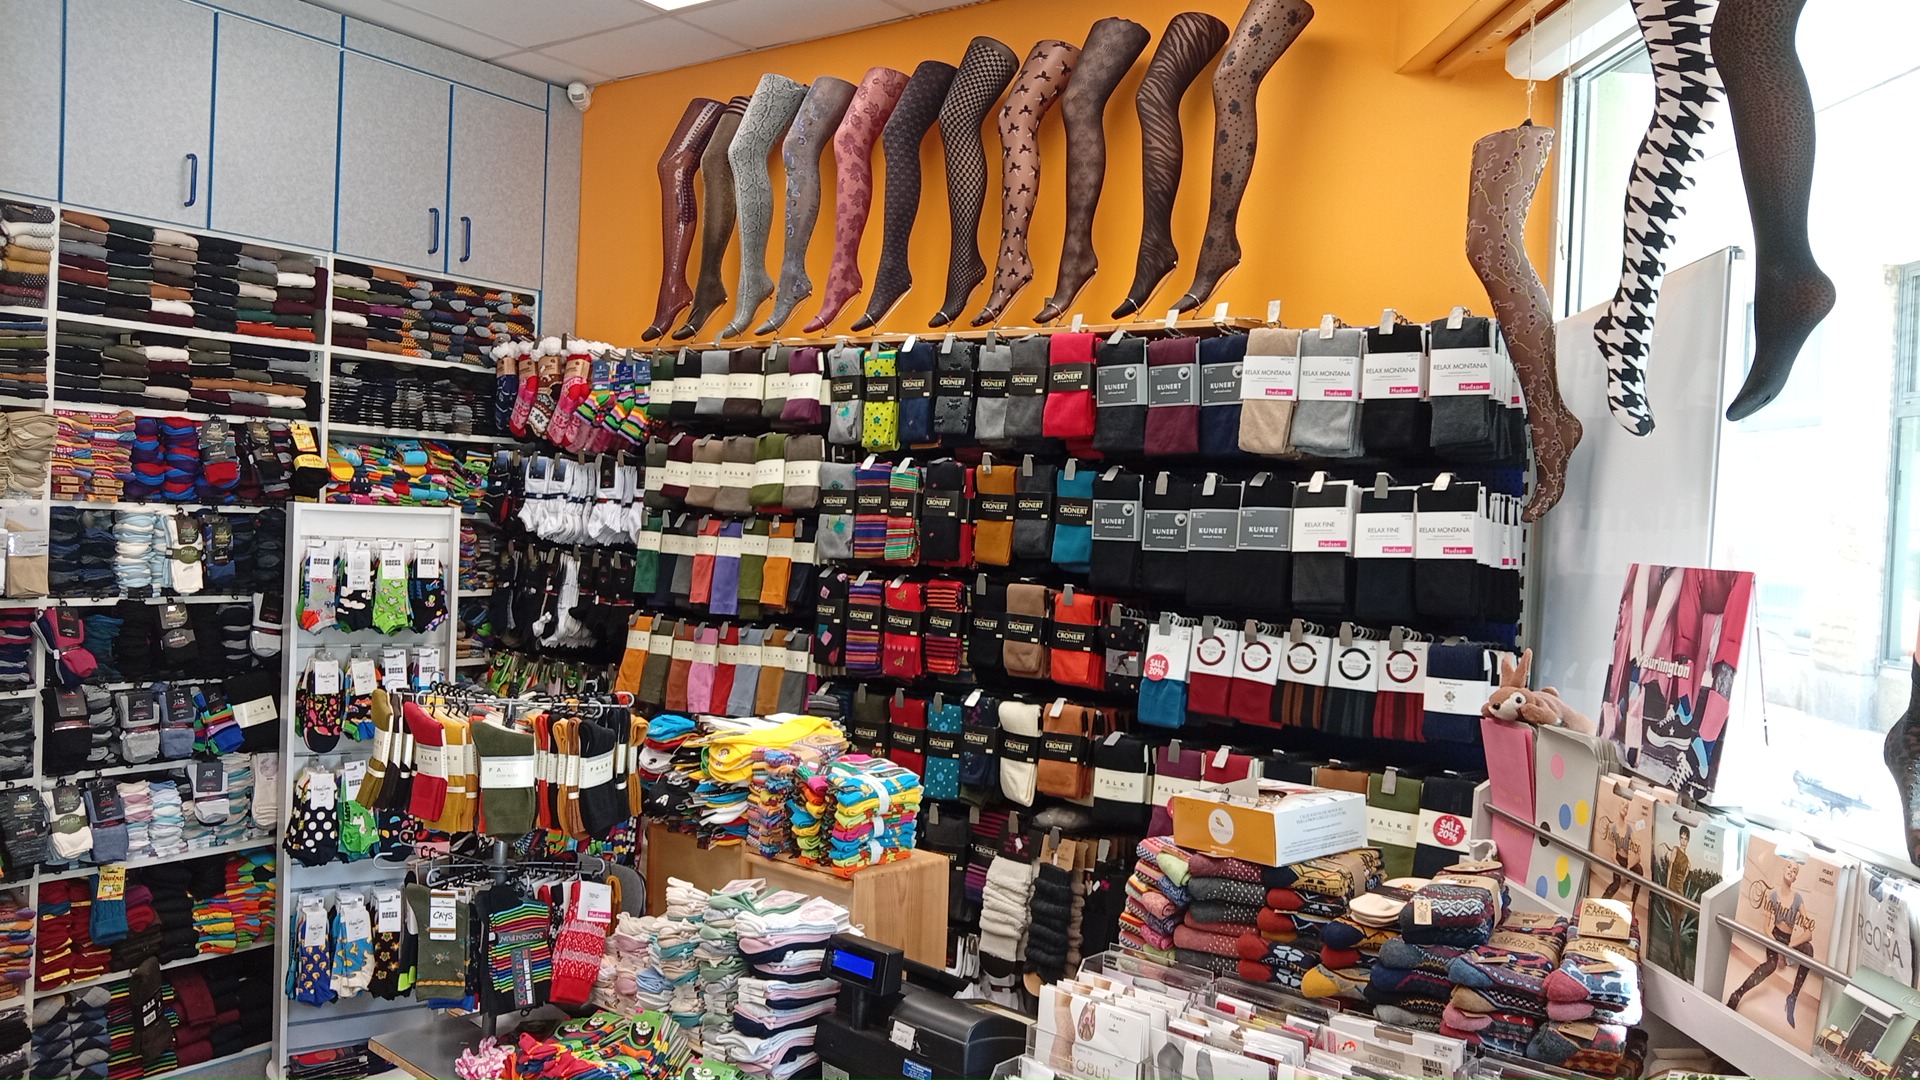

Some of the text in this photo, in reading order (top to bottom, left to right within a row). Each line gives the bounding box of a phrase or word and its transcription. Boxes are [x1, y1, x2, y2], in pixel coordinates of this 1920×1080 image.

[1011, 374, 1037, 384] CRONERT
[1053, 371, 1082, 382] CRONERT
[833, 382, 853, 392] CRONERT
[867, 383, 889, 391] CRONERT
[902, 379, 924, 388] CRONERT
[940, 378, 966, 387] CRONERT
[980, 379, 1006, 388] CRONERT
[1104, 383, 1128, 391] KUNERT
[1156, 383, 1181, 391] KUNERT
[1210, 381, 1235, 390] KUNERT
[823, 496, 847, 505] CRONERT
[858, 496, 882, 505] CRONERT
[926, 498, 950, 507] CRONERT
[1018, 500, 1043, 510] CRONERT
[982, 502, 1008, 511] CRONERT
[1059, 505, 1088, 515] CRONERT
[849, 610, 873, 620] CRONERT
[887, 617, 912, 626] CRONERT
[929, 617, 952, 627] CRONERT
[973, 619, 998, 628] CRONERT
[1008, 622, 1034, 632] CRONERT
[1057, 631, 1085, 641] CRONERT
[1149, 658, 1167, 669] SALE
[1642, 655, 1690, 679] Burlington
[1148, 667, 1164, 677] 20%
[855, 728, 877, 738] CRONERT
[893, 732, 916, 743] CRONERT
[964, 733, 989, 743] CRONERT
[929, 739, 954, 749] CRONERT
[1004, 740, 1030, 751] CRONERT
[1045, 740, 1073, 751] CRONERT
[420, 754, 438, 762] ALKE
[1099, 778, 1134, 788] FALKE
[1370, 818, 1412, 831] FALKE
[1440, 819, 1462, 834] SALE
[1437, 829, 1458, 843] 20%
[975, 845, 999, 856] CRONER
[1822, 868, 1834, 876] maxi
[432, 910, 454, 922] CAYS
[1109, 1013, 1126, 1023] Flowers
[1368, 1055, 1402, 1070] DESIGN
